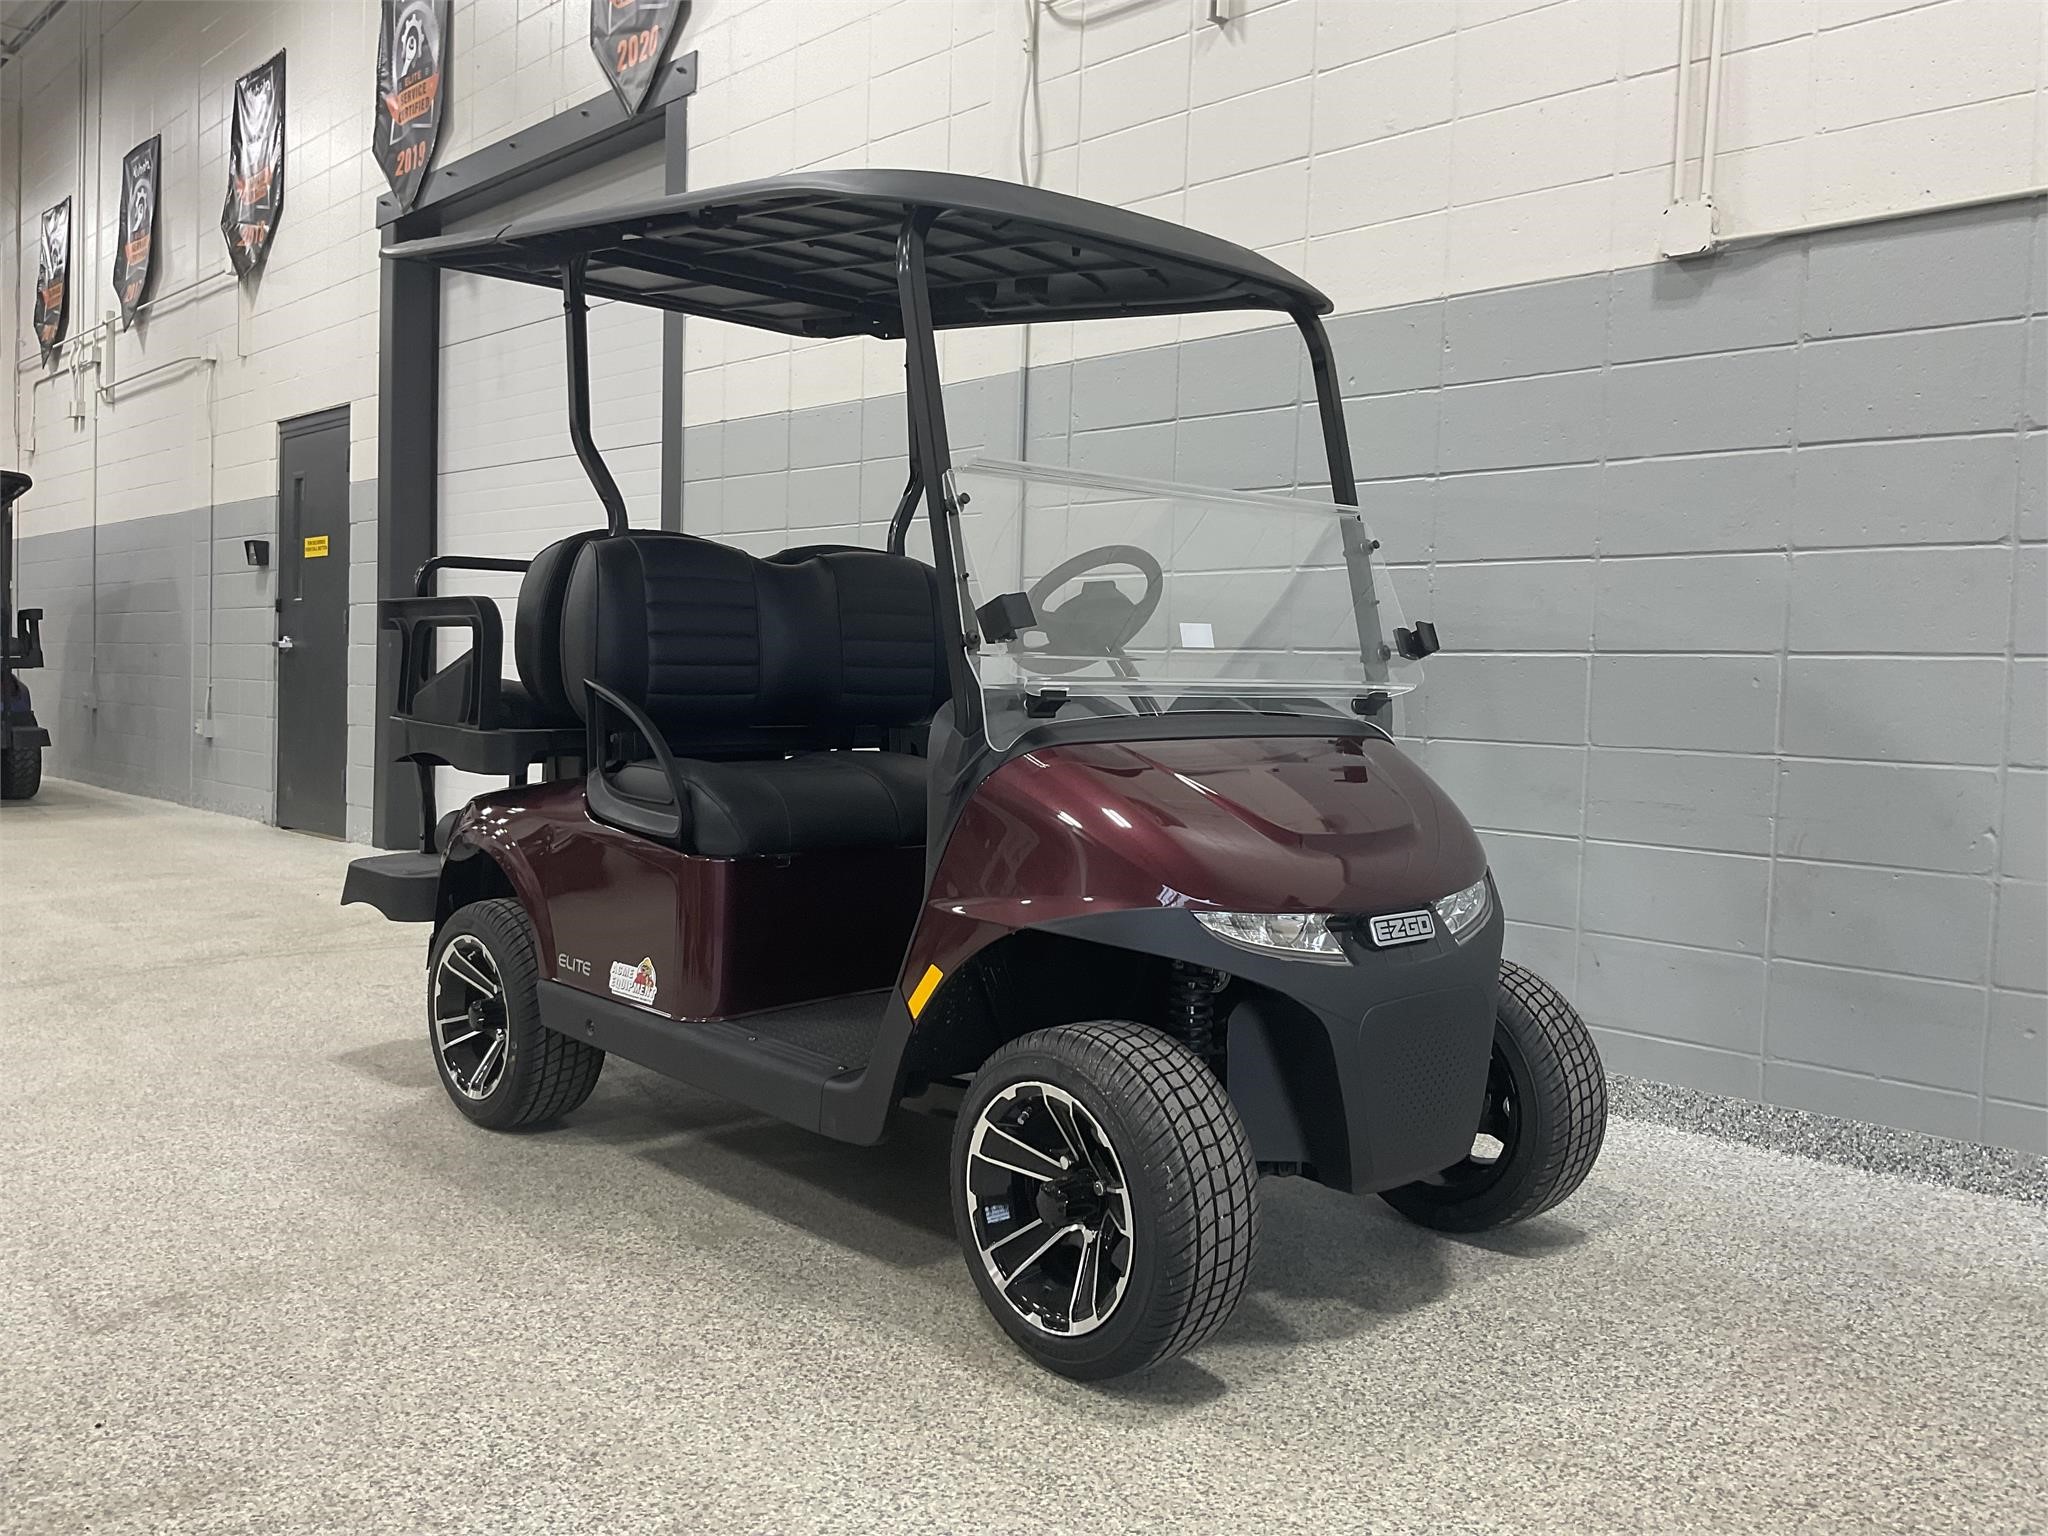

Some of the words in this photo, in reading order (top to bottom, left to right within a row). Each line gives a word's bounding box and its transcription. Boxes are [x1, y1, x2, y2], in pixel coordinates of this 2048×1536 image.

[616, 24, 659, 72] 2020
[400, 81, 427, 106] SERVICE
[395, 140, 426, 176] 2019
[1375, 915, 1432, 941] EZGO
[558, 953, 592, 976] ELITE
[611, 964, 635, 980] ACME
[610, 976, 656, 999] EQUIPMENT
